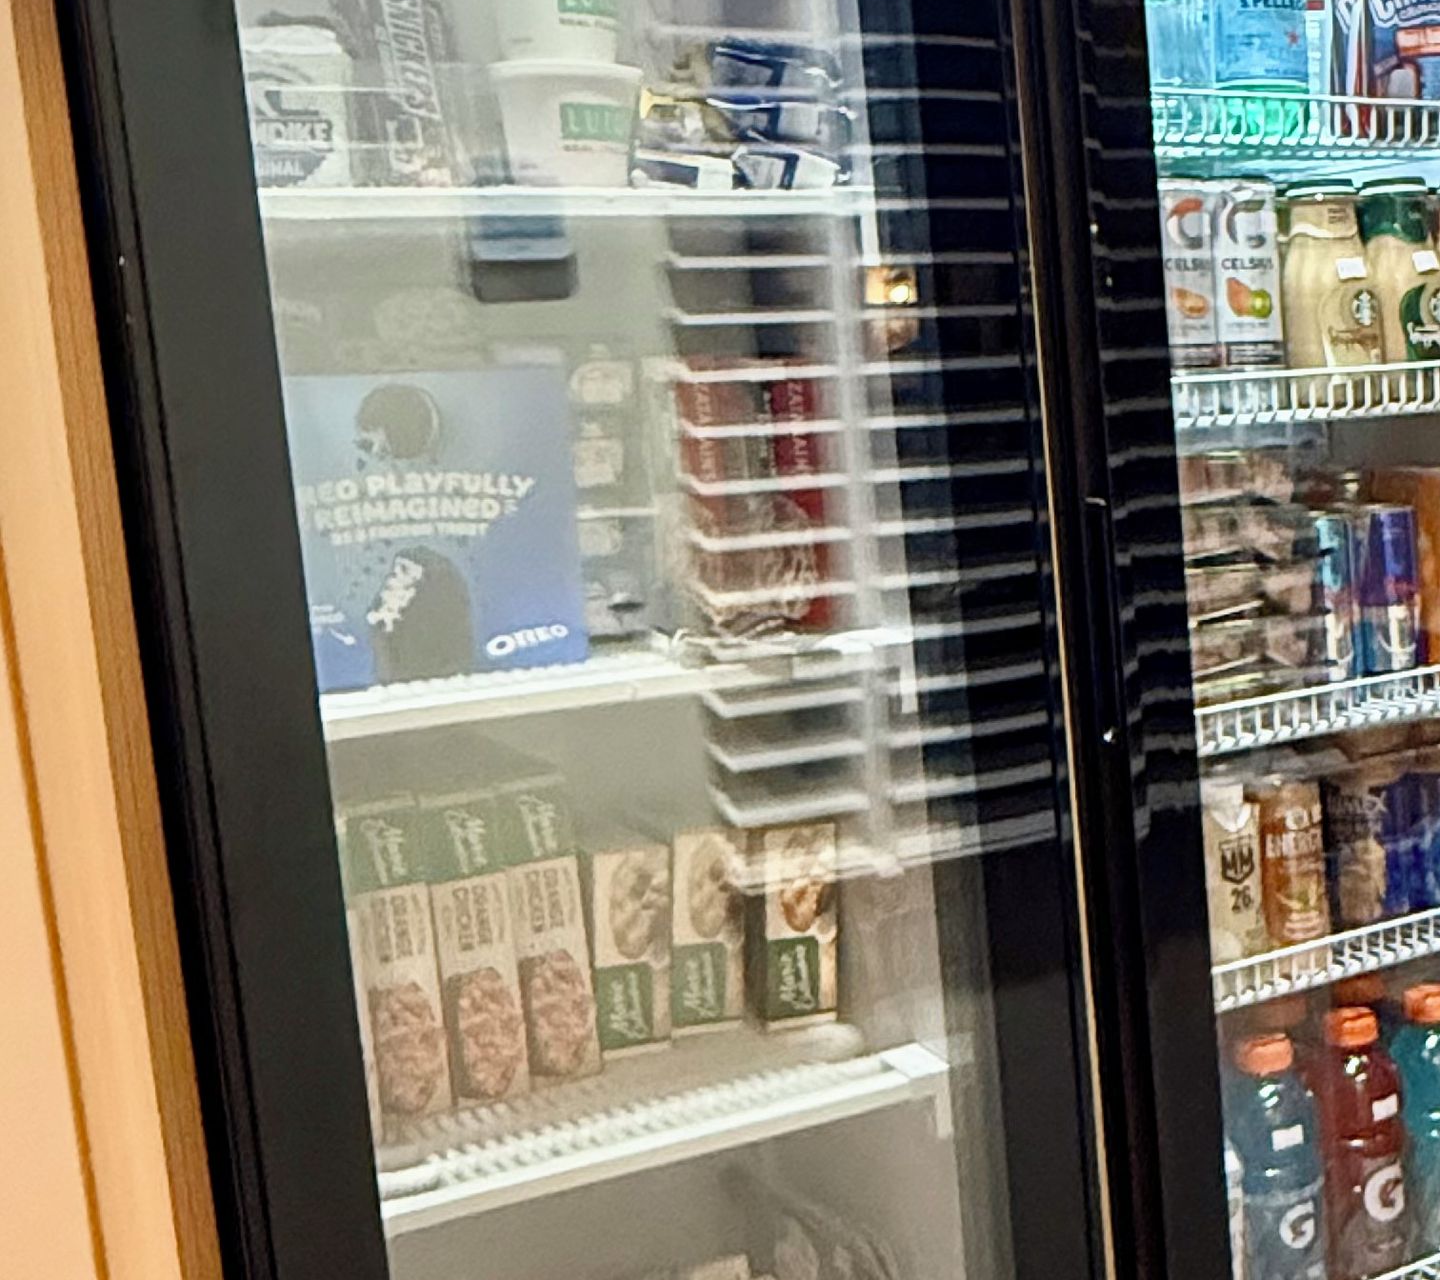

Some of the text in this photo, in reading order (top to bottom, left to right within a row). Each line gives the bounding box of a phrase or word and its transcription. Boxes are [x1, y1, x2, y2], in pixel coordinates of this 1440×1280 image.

[300, 471, 536, 507] REO PLAYFULLY
[314, 497, 502, 529] REIMAGINED
[486, 623, 569, 657] OREO
[1364, 1162, 1405, 1222] G
[1279, 1201, 1315, 1249] G
